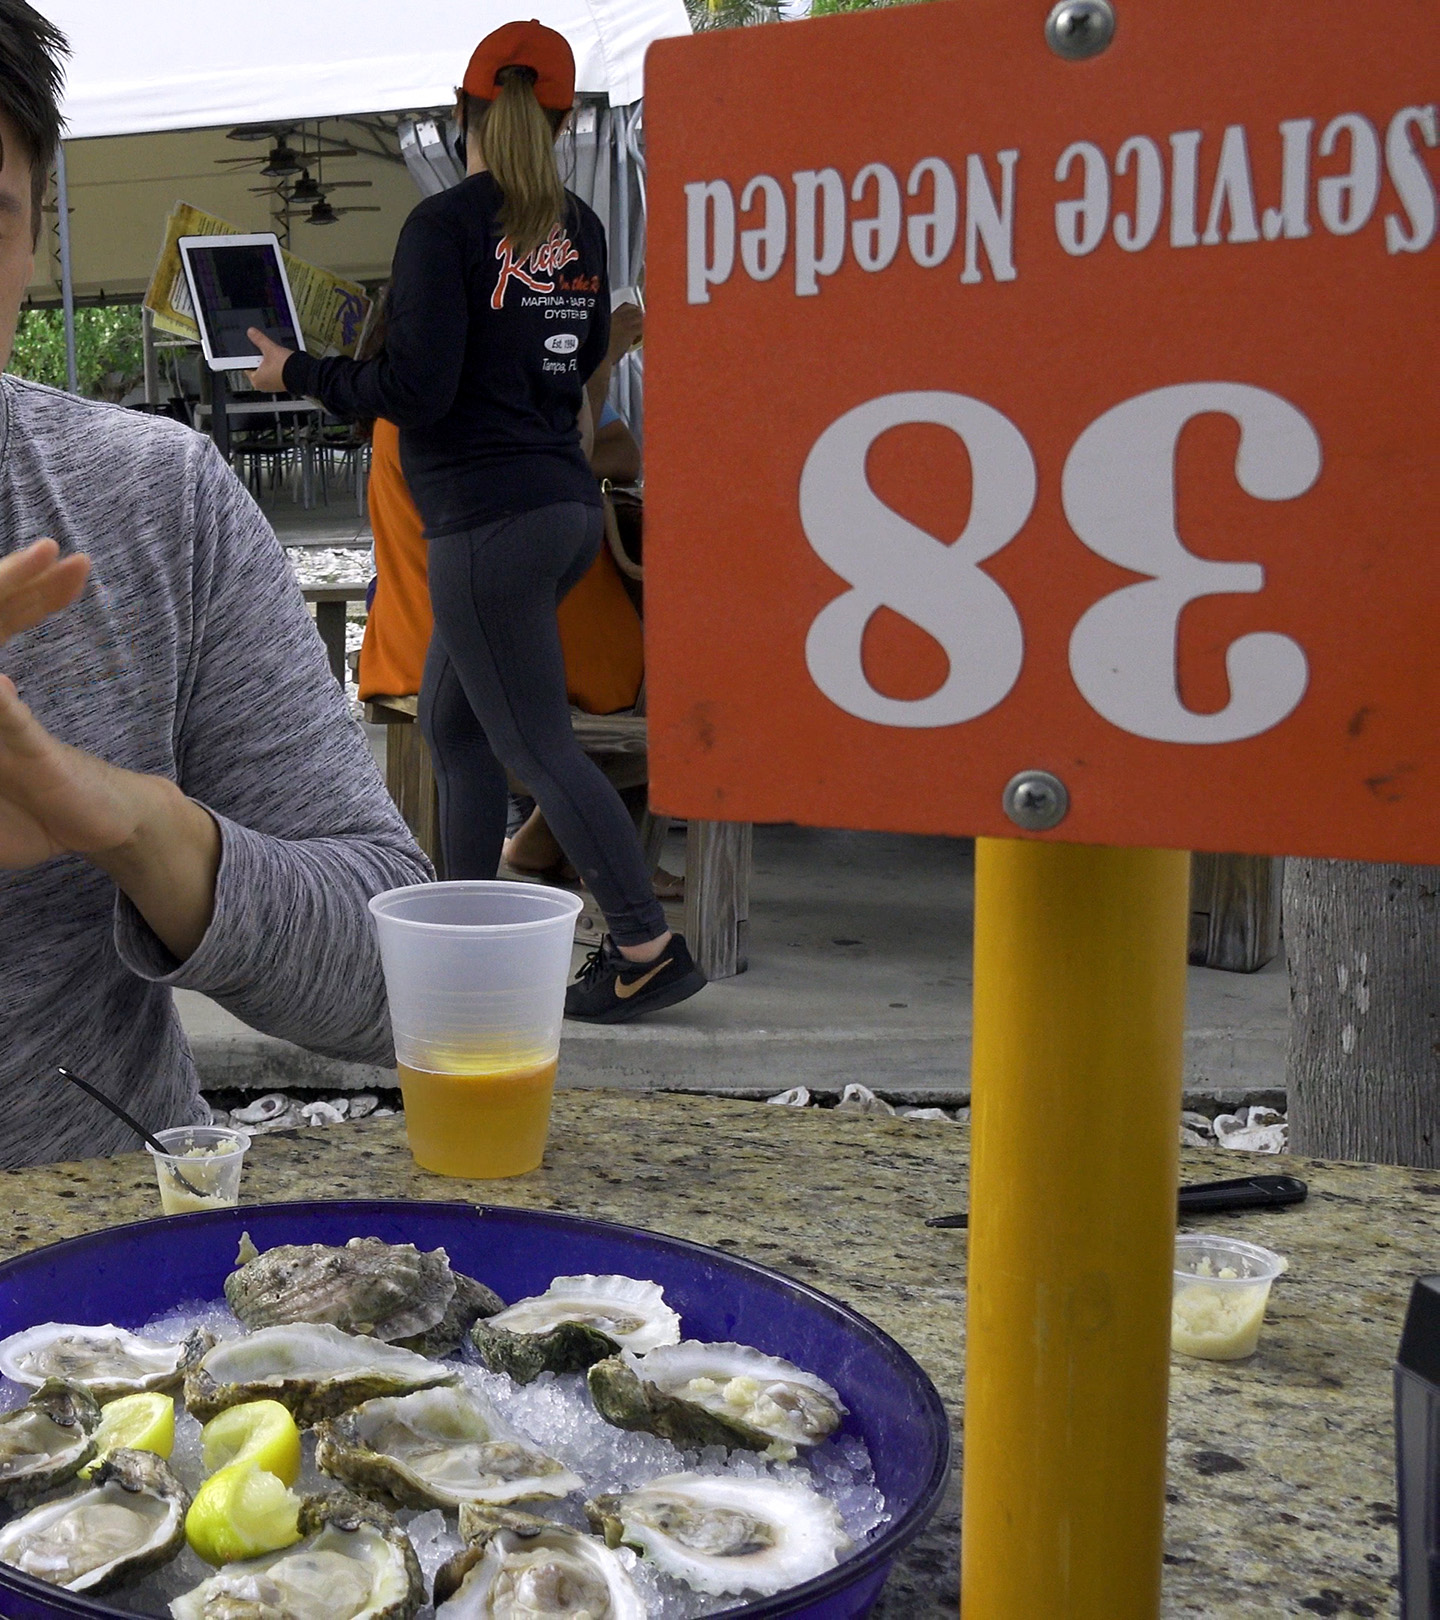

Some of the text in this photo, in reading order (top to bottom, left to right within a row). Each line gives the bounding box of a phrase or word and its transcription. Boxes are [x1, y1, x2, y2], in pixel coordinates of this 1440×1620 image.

[521, 296, 565, 307] MARINA
[683, 104, 1440, 305] Service Needed
[798, 380, 1324, 745] 38
